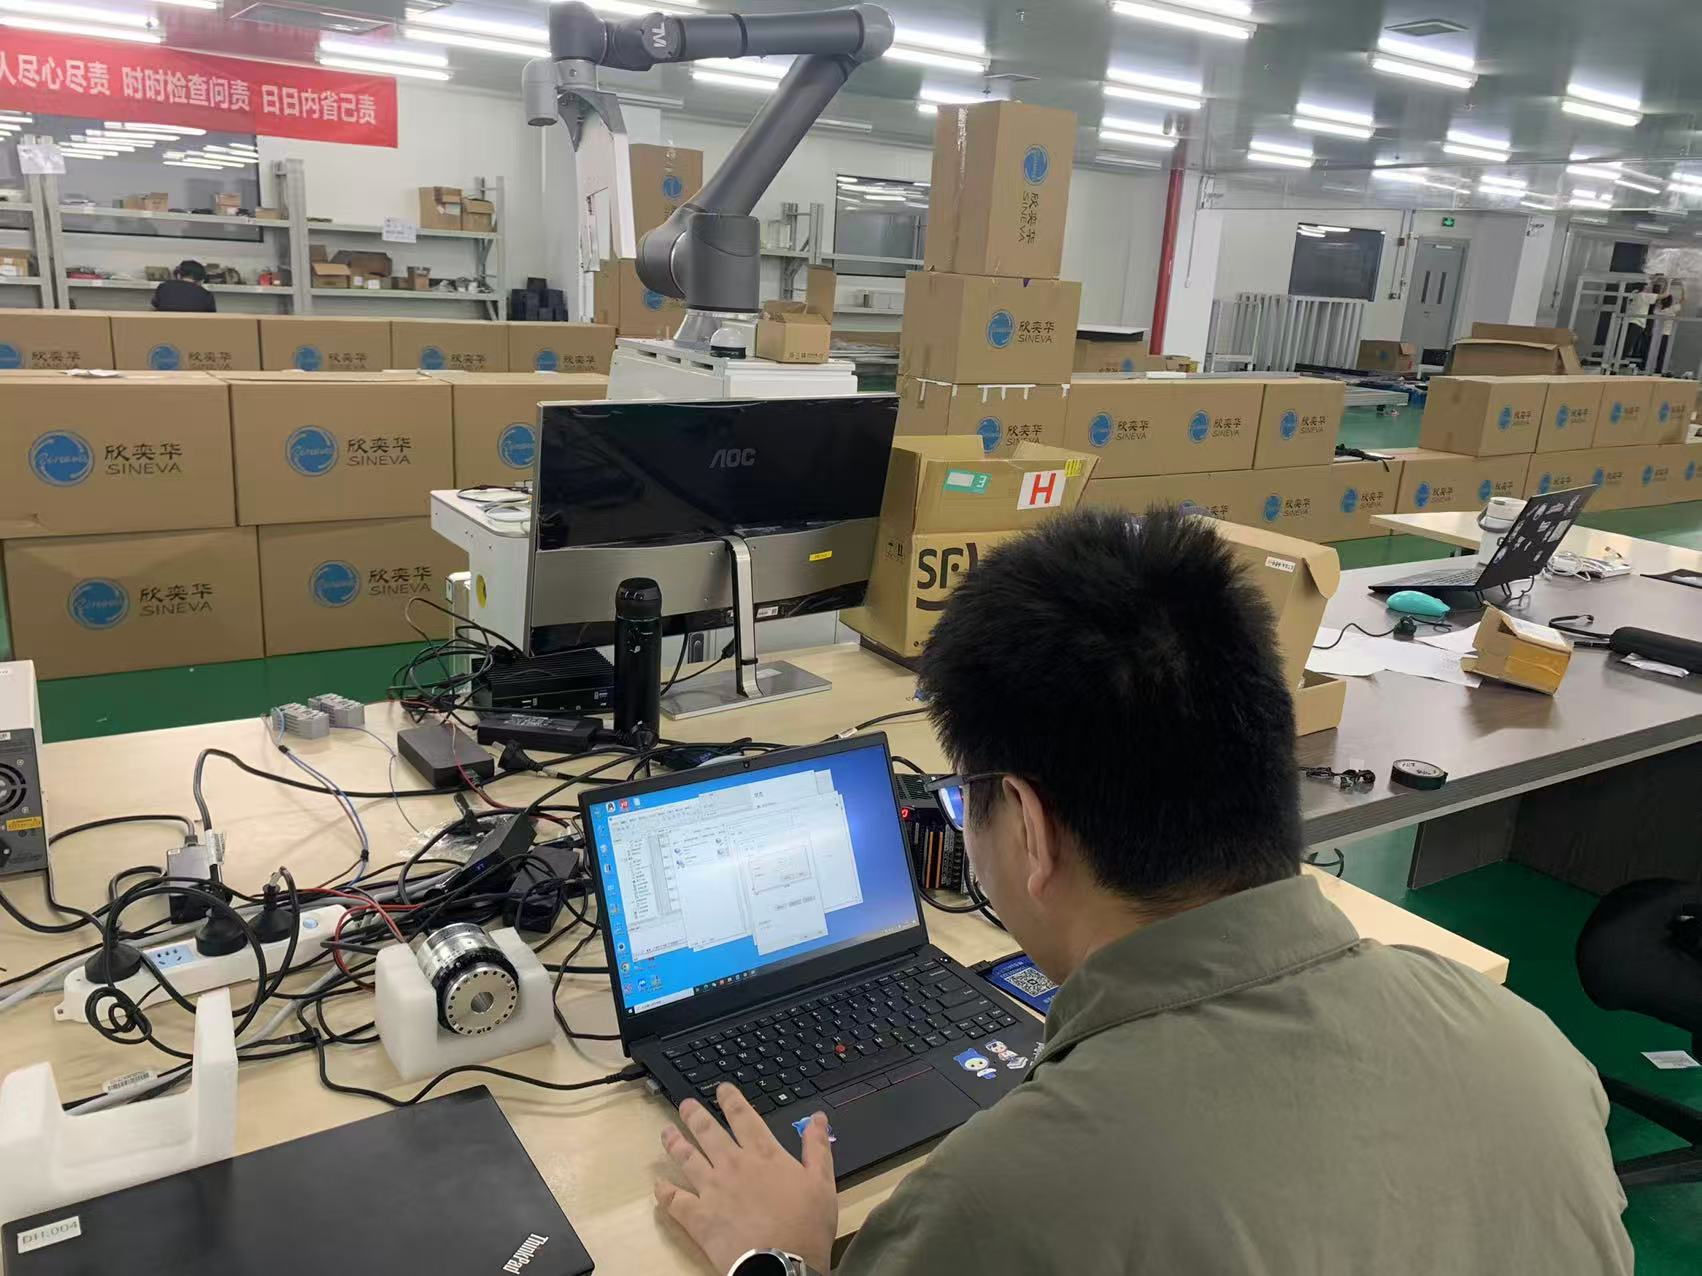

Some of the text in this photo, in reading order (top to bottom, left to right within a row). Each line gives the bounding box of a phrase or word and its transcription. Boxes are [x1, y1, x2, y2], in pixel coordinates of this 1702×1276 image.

[122, 67, 250, 112] 时时检查问责
[262, 84, 377, 125] 日日内省己责
[1018, 191, 1030, 242] SINEVA
[1026, 193, 1039, 244] 欣奕华
[1018, 320, 1055, 334] 欣奕华
[1018, 334, 1053, 344] SINEVA
[1006, 424, 1042, 438] 欣奕华
[1116, 420, 1150, 432] 欣奕华
[1213, 417, 1243, 430] 欣奕华
[347, 435, 413, 454] 欣奕华
[1116, 432, 1147, 441] SINEVA
[103, 442, 183, 463] 欣奕华
[347, 454, 412, 467] SINEVA
[709, 447, 757, 469] AOC
[105, 462, 183, 477] SINEVA
[1029, 472, 1057, 505] H
[368, 566, 433, 584] 欣奕华
[140, 583, 214, 603] 欣奕华
[369, 582, 431, 597] SINEVA
[140, 601, 213, 617] SINEVA
[502, 1233, 549, 1275] ThinkPad
